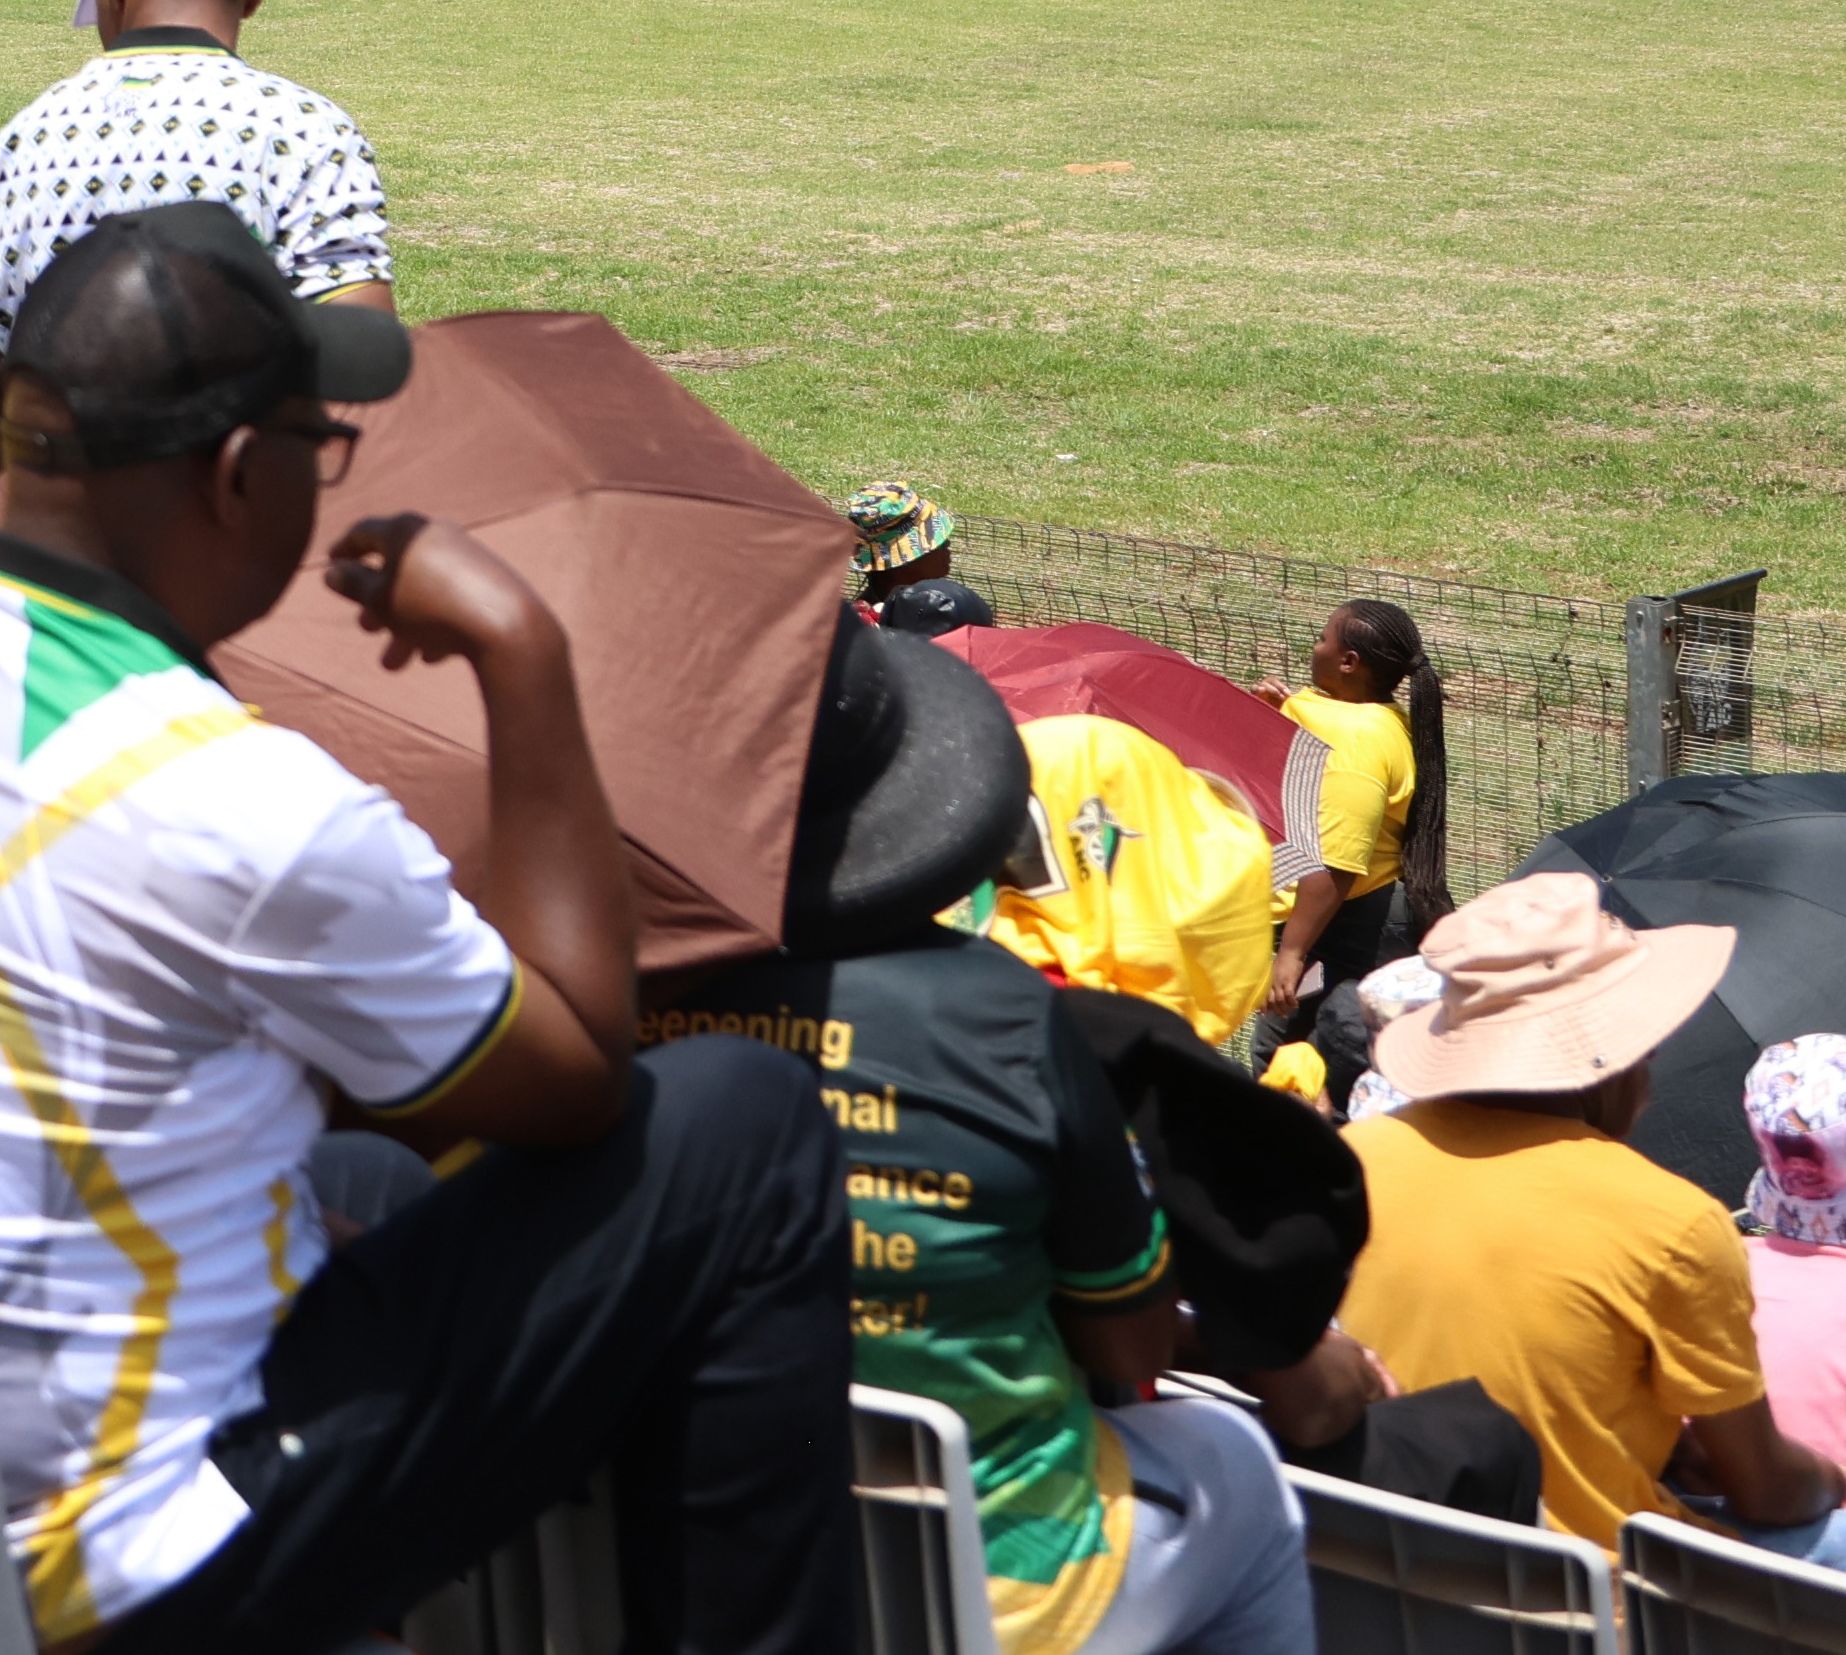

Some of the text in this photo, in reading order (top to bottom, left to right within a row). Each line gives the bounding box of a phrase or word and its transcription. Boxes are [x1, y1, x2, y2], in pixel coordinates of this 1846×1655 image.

[636, 1006, 853, 1070] eepening
[845, 1163, 974, 1210] ance
[851, 1218, 918, 1271] he
